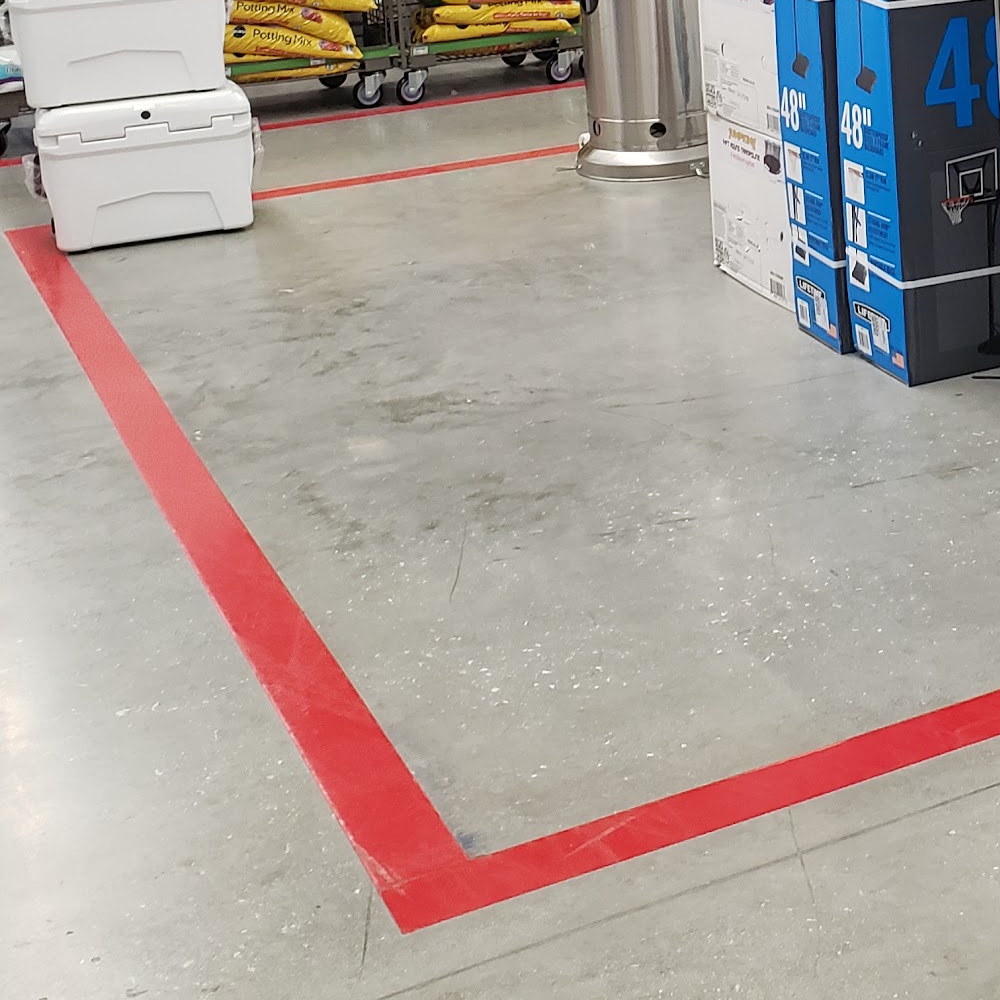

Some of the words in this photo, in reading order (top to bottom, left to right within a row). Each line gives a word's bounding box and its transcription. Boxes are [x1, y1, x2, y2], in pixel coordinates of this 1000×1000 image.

[236, 1, 274, 14] Potting
[277, 4, 296, 13] Mix
[252, 28, 292, 44] Potting
[293, 35, 312, 47] Mix
[781, 86, 806, 132] 48"
[841, 101, 872, 149] 48"
